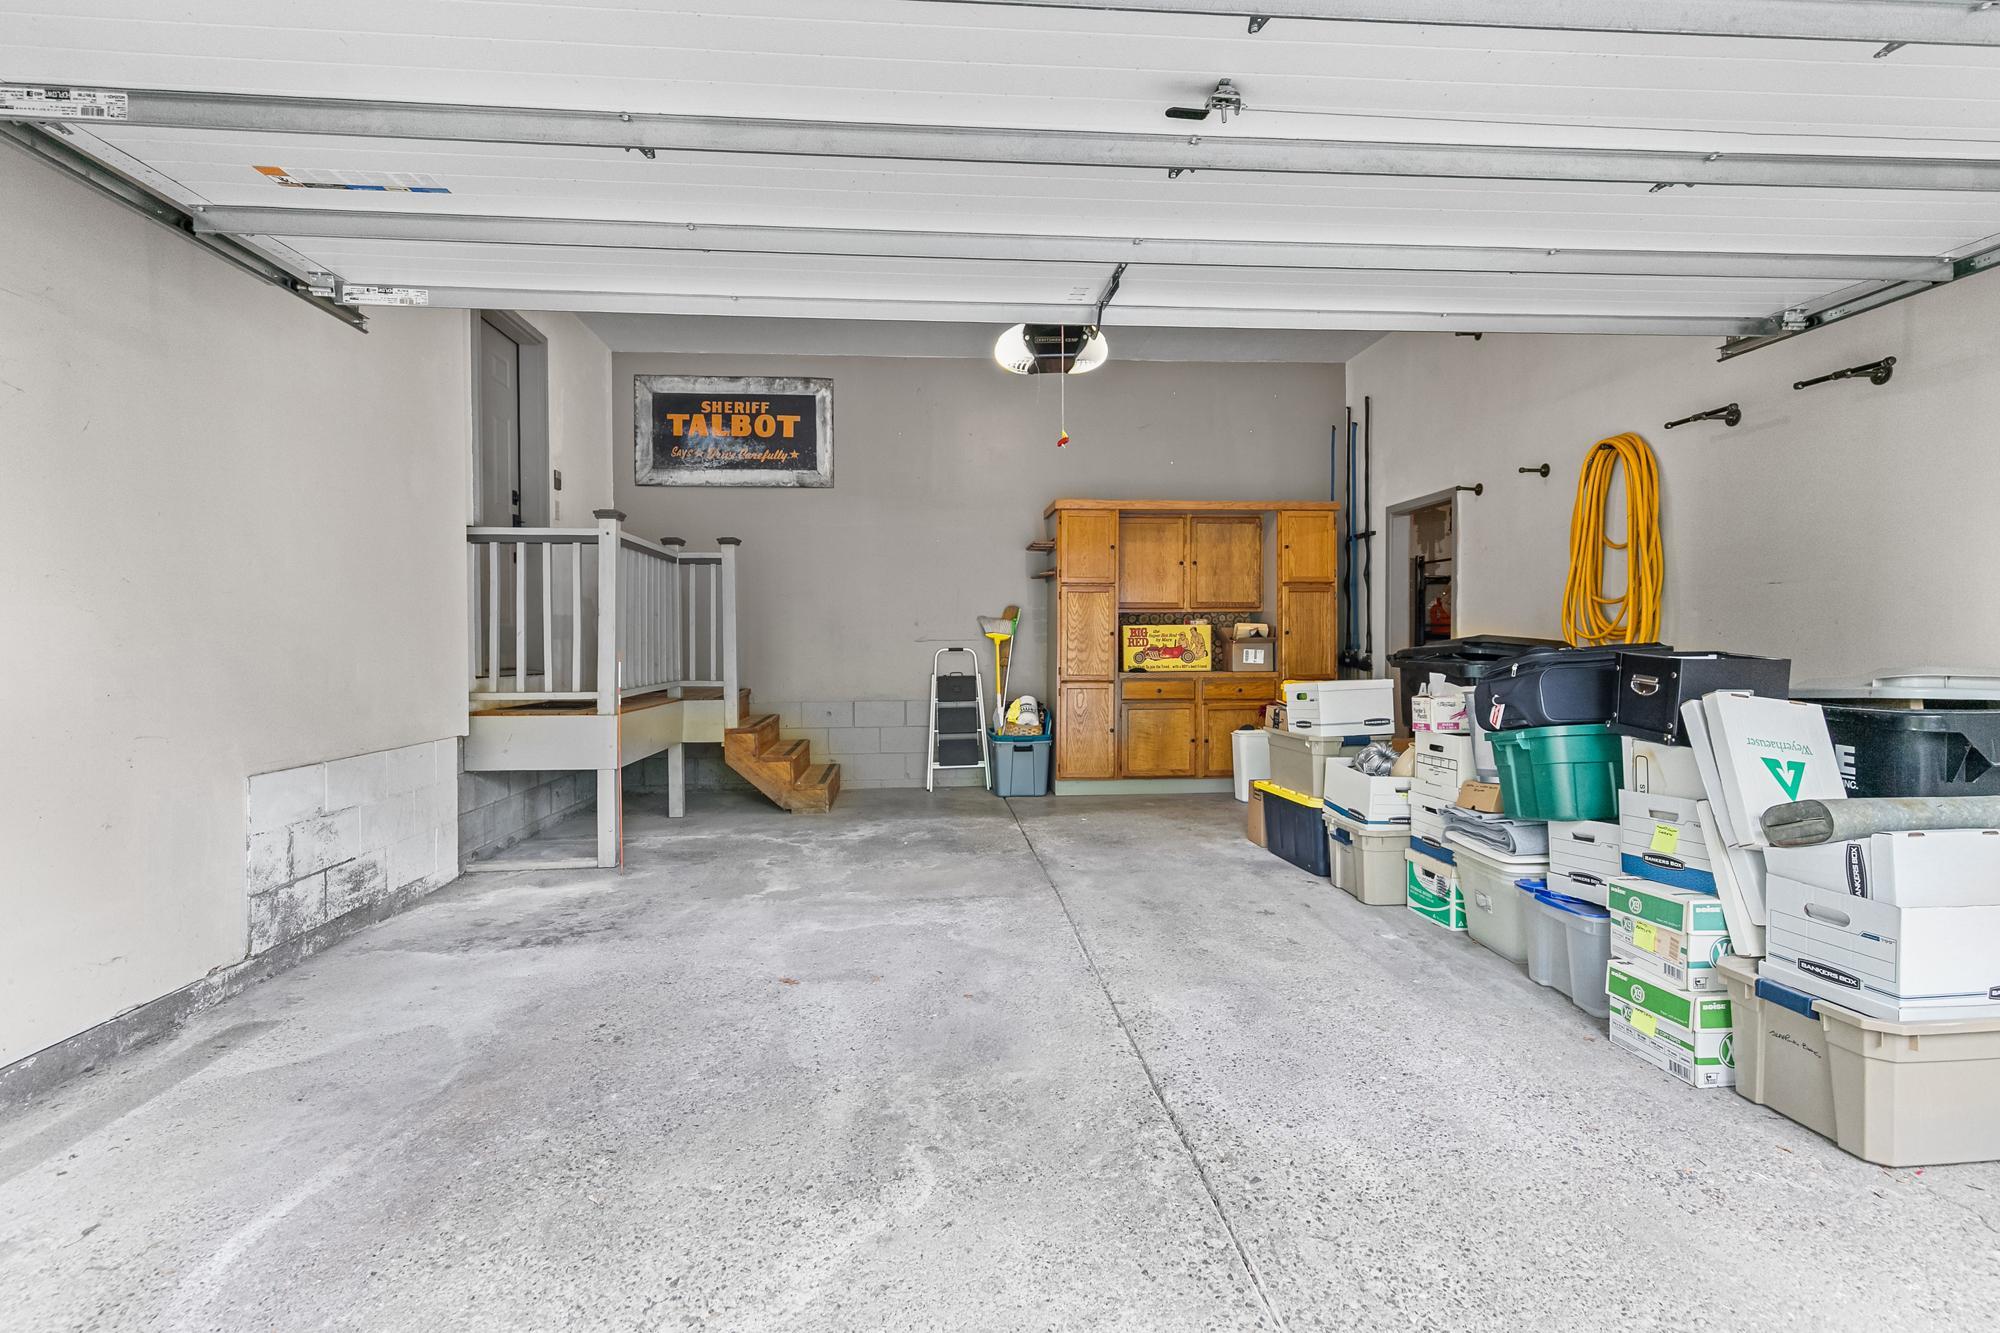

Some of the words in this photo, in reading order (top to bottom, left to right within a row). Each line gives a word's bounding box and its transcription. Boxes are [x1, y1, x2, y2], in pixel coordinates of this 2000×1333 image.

[701, 401, 770, 414] SHERIFF
[666, 413, 800, 438] TALBOT
[1129, 628, 1148, 638] BIG
[1127, 638, 1149, 648] RED
[1746, 737, 1813, 755] Weyerhaeuser
[1835, 744, 1856, 775] E
[1844, 781, 1859, 790] NC.
[1644, 855, 1670, 865] BANKERS
[1670, 860, 1682, 868] BOX
[1852, 864, 1862, 897] ANKERS
[1801, 962, 1839, 980] BANKERS
[1838, 975, 1858, 987] BOX
